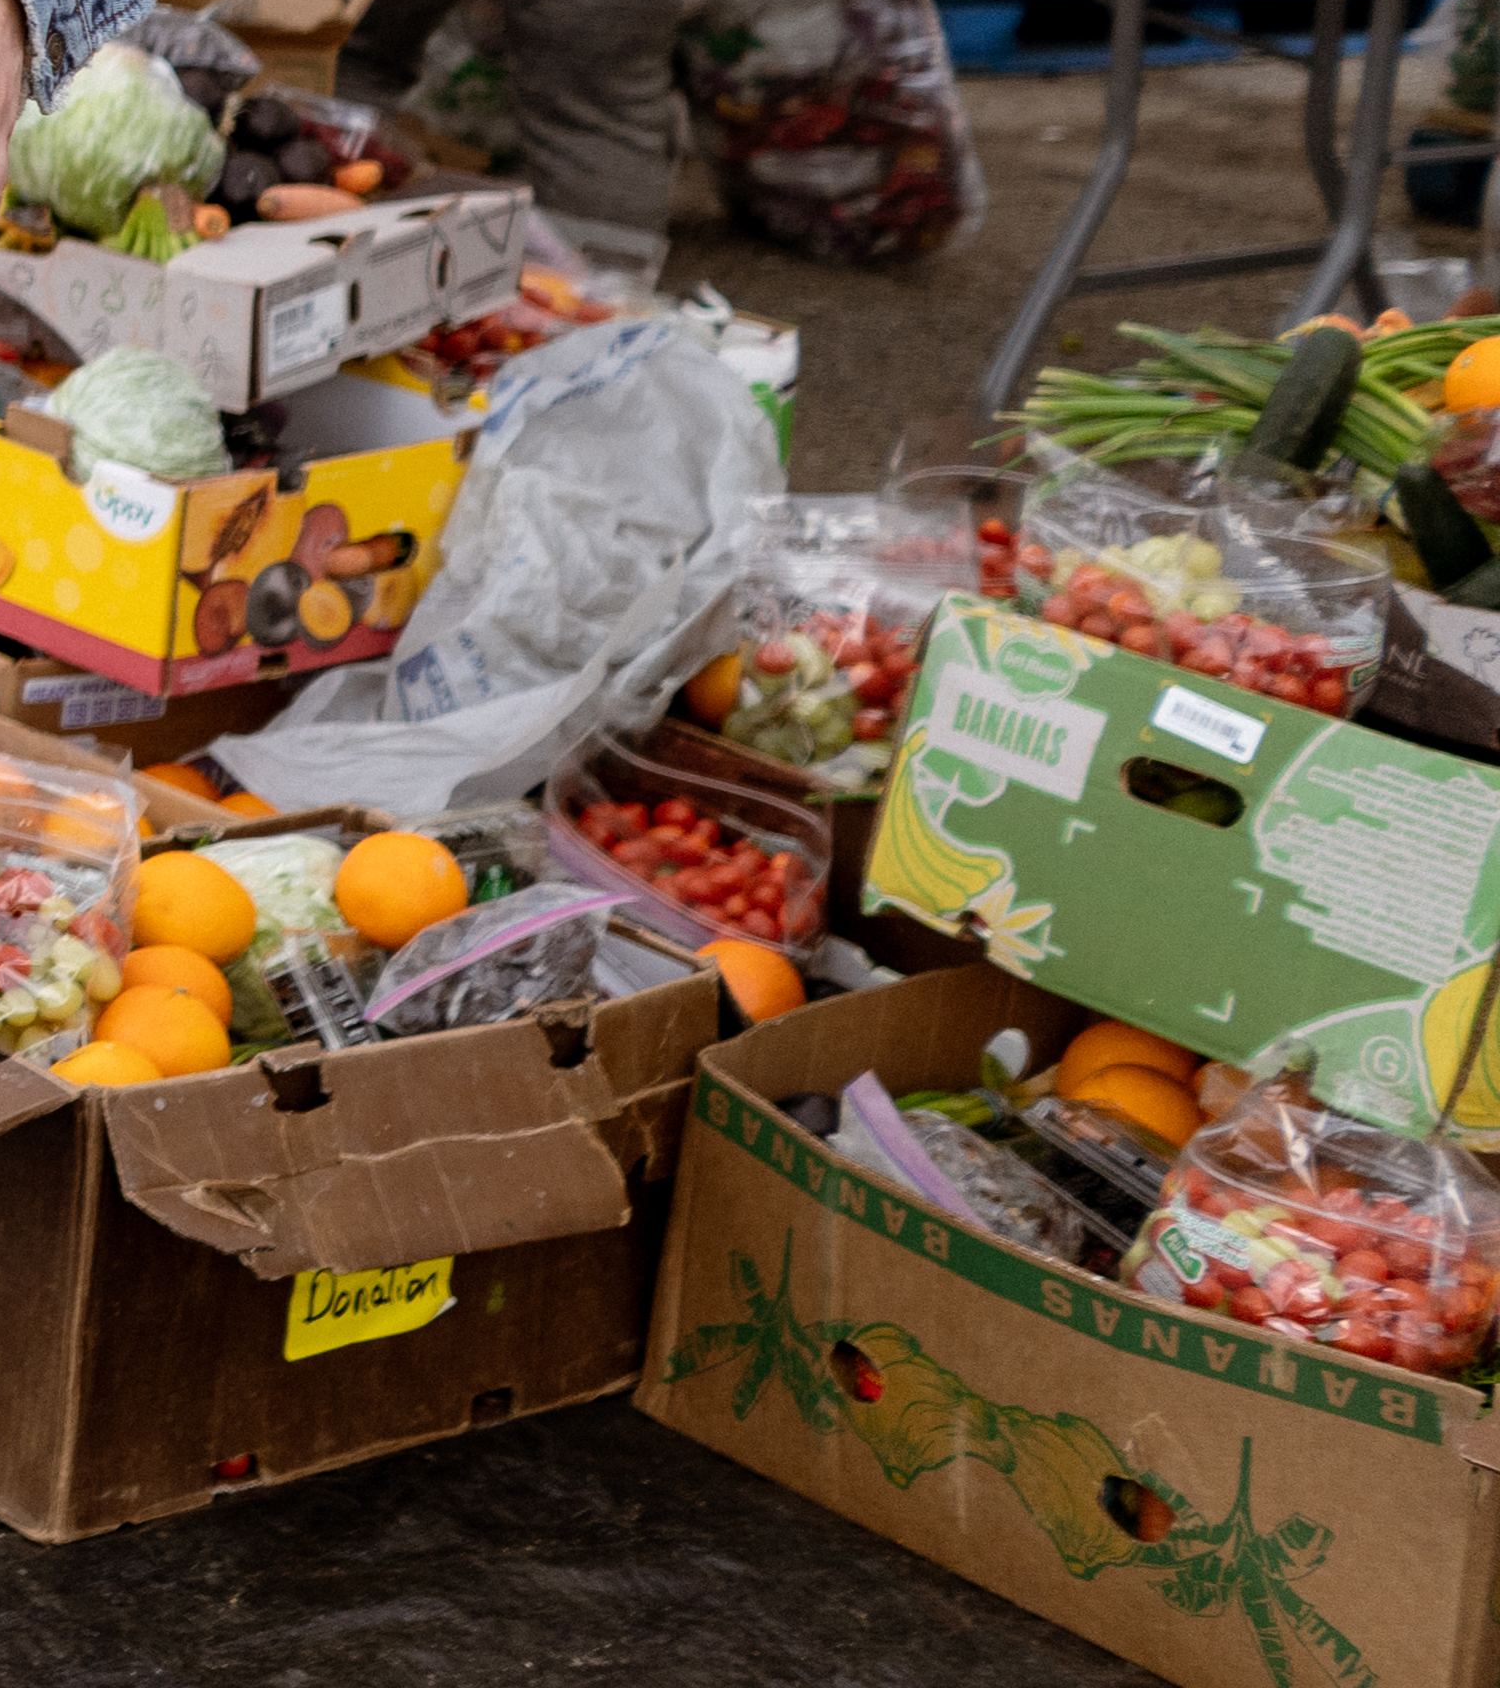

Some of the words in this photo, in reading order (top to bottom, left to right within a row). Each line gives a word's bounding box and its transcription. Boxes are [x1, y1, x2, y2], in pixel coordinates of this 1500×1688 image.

[953, 691, 1069, 767] BANANAS
[705, 1086, 952, 1262] BANANAS
[301, 1263, 439, 1325] Donation
[1041, 1278, 1420, 1430] BANANAS
